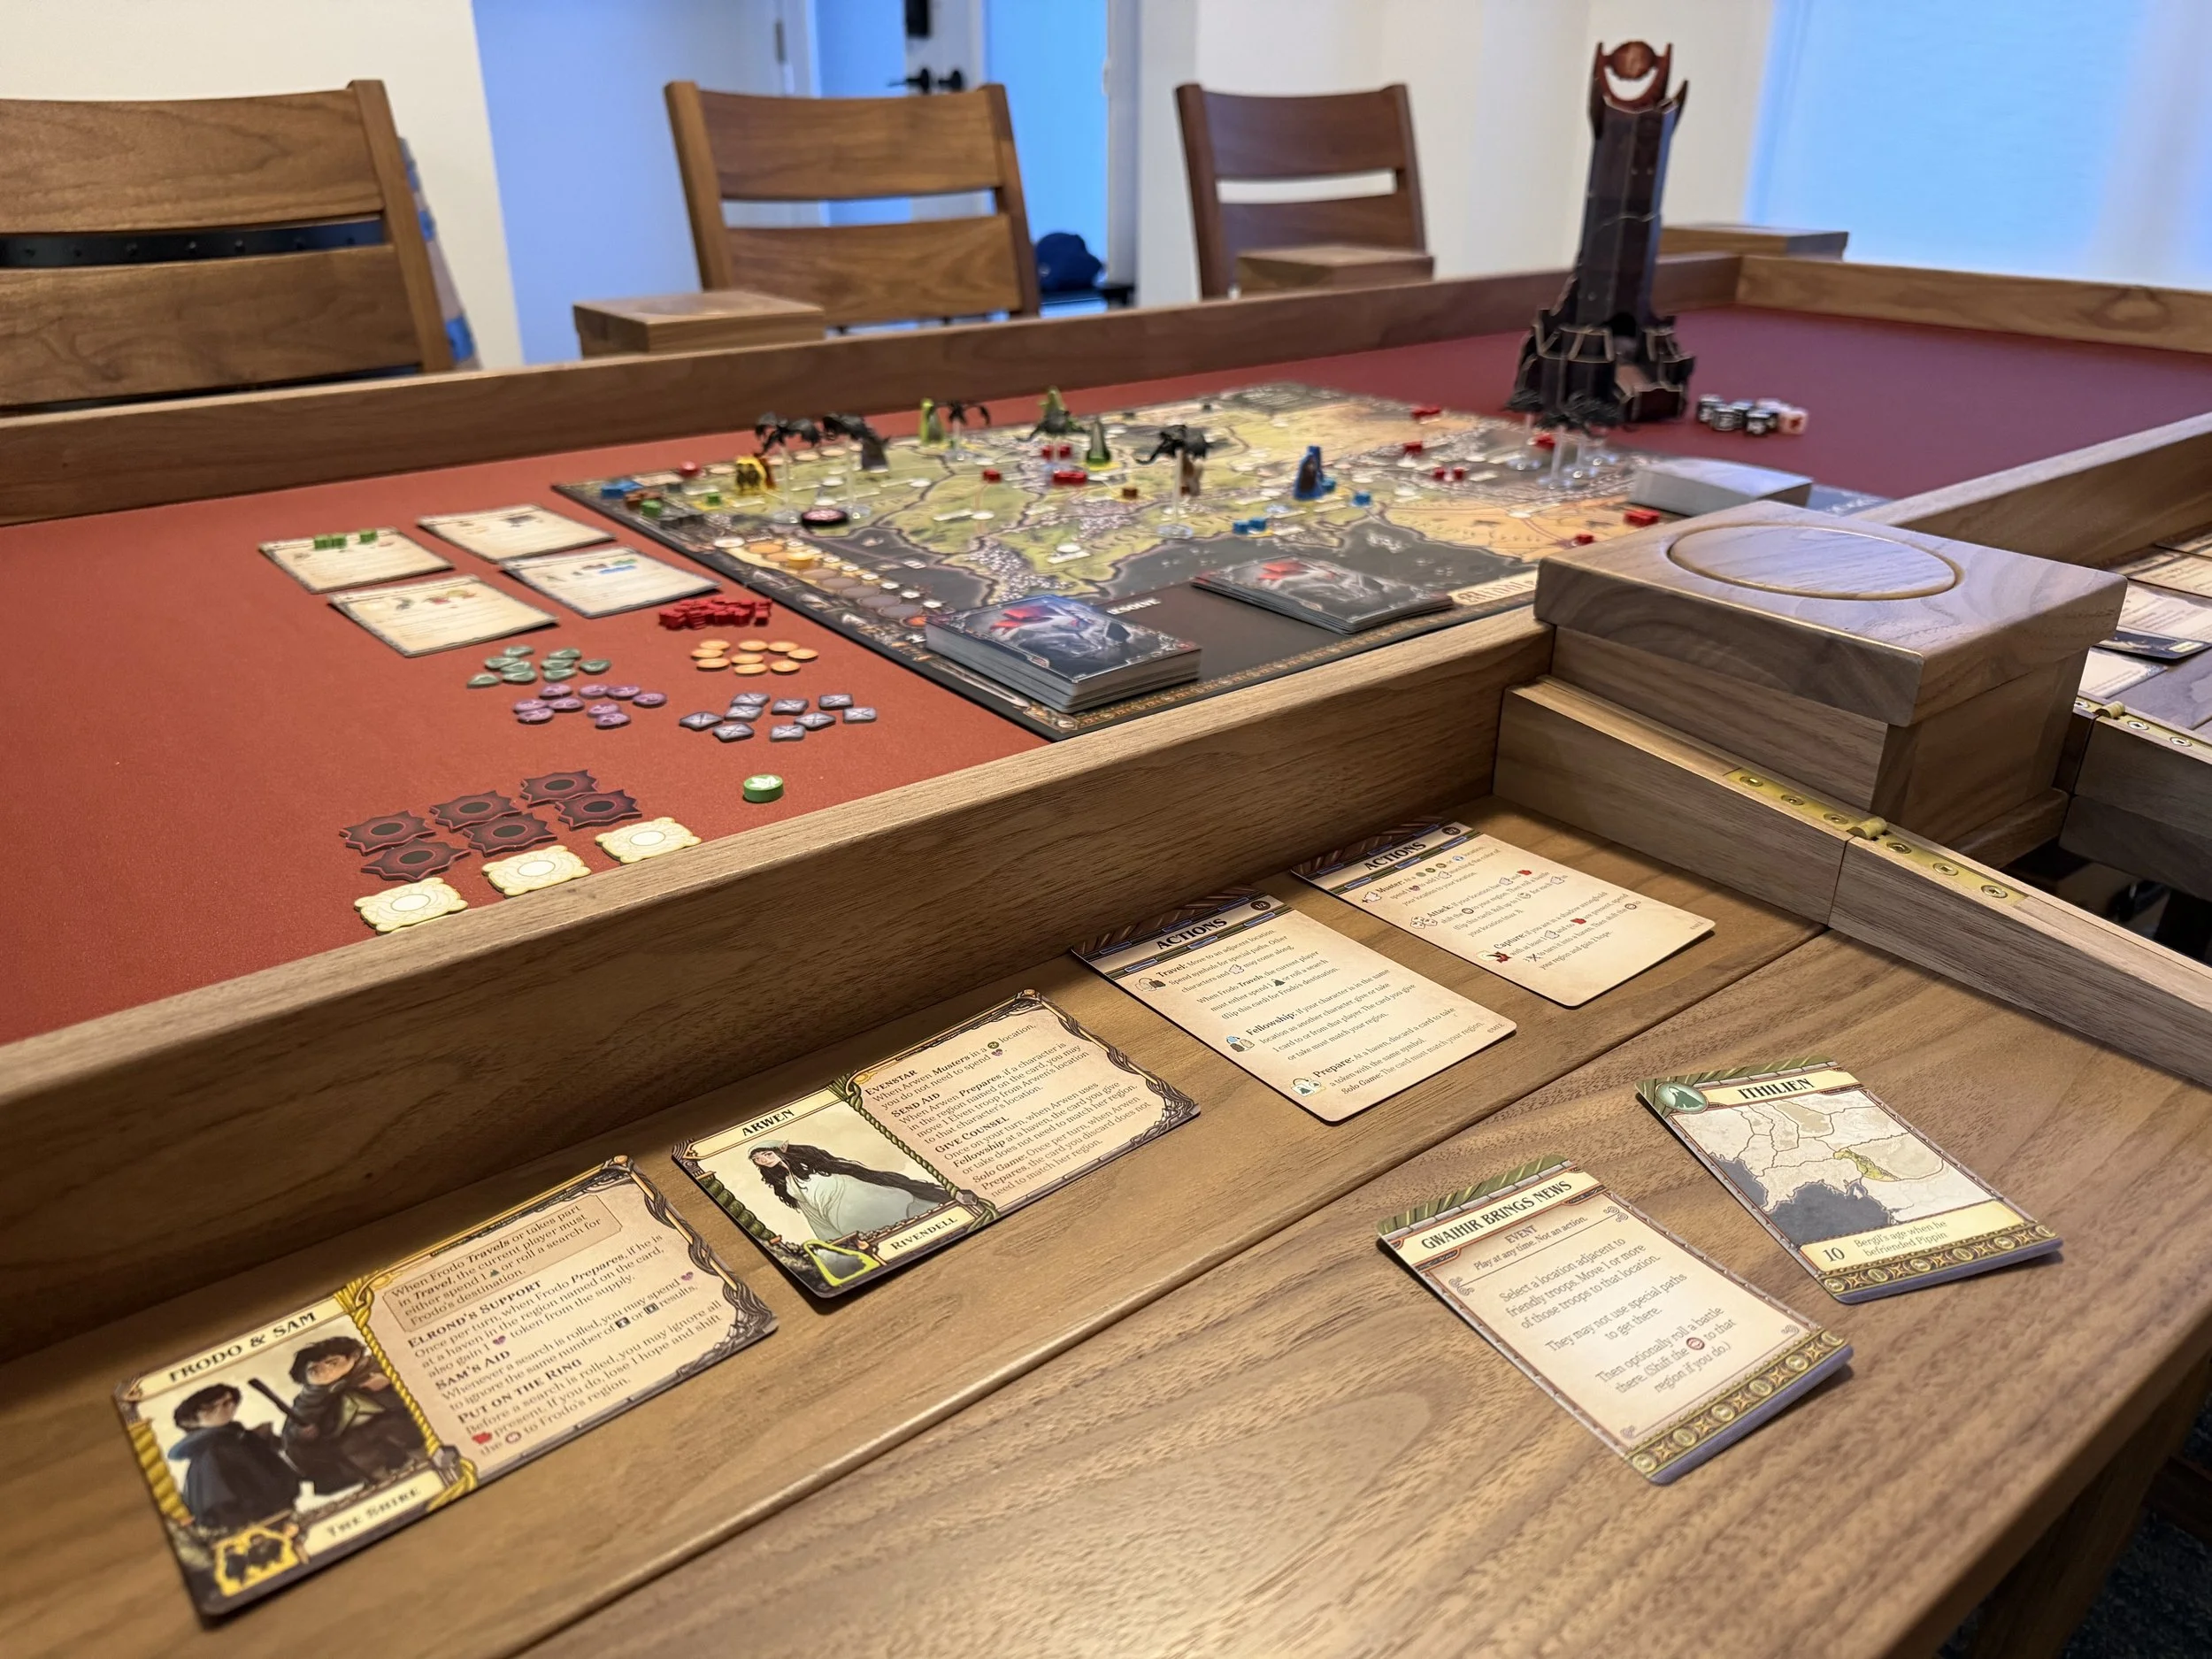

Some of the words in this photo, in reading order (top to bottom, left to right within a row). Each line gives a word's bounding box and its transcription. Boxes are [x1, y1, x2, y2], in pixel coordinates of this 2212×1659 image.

[1156, 918, 1228, 949] ACTIONS
[1302, 1002, 1319, 1012] your
[1317, 988, 1349, 1004] character
[1372, 970, 1391, 979] same
[872, 1087, 903, 1102] When
[902, 1073, 933, 1090] Arwen
[932, 1056, 972, 1076] Musters
[998, 1025, 1037, 1043] location,
[1295, 1048, 1313, 1057] take
[1311, 1040, 1331, 1050] must
[1328, 1029, 1352, 1042] match
[1348, 1023, 1366, 1033] your
[864, 1070, 918, 1095] EVENSTAR
[881, 1098, 902, 1110] you
[900, 1092, 914, 1101] do
[913, 1084, 932, 1094] not
[930, 1072, 955, 1087] need
[964, 1054, 992, 1071] spend
[891, 1102, 921, 1118] SEND
[921, 1093, 941, 1104] AID
[898, 1110, 930, 1124] When
[929, 1095, 961, 1112] Arwen
[958, 1074, 1006, 1097] Prepares,
[1018, 1047, 1058, 1068] character
[917, 1123, 944, 1138] move
[947, 1108, 977, 1122] Elven
[974, 1095, 1002, 1110] troop
[999, 1085, 1024, 1097] from
[1022, 1069, 1056, 1087] Arwen's
[1053, 1051, 1090, 1071] location
[918, 1116, 937, 1125] the
[936, 1102, 968, 1118] region
[966, 1086, 998, 1103] named
[1009, 1073, 1026, 1082] the
[1025, 1062, 1049, 1075] card,
[1046, 1055, 1064, 1066] you
[1063, 1045, 1082, 1056] may
[1738, 1079, 1816, 1099] ITHILIEN
[742, 1109, 795, 1136] ARWEN
[935, 1127, 957, 1139] that
[956, 1103, 1007, 1129] character's
[1003, 1087, 1044, 1105] location.
[935, 1138, 964, 1153] GIVE
[961, 1117, 1010, 1141] COUNSEL
[943, 1147, 972, 1160] Once
[982, 1129, 1005, 1144] your
[1003, 1120, 1029, 1132] turn,
[1025, 1107, 1052, 1121] when
[1050, 1093, 1080, 1110] Arwen
[1078, 1083, 1100, 1094] uses
[953, 1140, 1006, 1168] Fellowship
[1020, 1118, 1054, 1133] haven,
[1050, 1110, 1068, 1119] the
[1066, 1098, 1087, 1111] card
[1086, 1091, 1104, 1103] you
[1102, 1082, 1121, 1094] give
[890, 1217, 958, 1250] RIVENDELL
[1421, 1219, 1485, 1249] GWAIHIR
[1480, 1197, 1536, 1225] BRINGS
[1532, 1180, 1573, 1202] NEWS
[1504, 1225, 1538, 1243] EVENT
[1854, 1233, 1891, 1250] Bergil's
[1889, 1231, 1909, 1240] age
[1907, 1225, 1935, 1235] when
[391, 1279, 429, 1297] When
[429, 1262, 466, 1281] Frodo
[465, 1240, 511, 1263] Travels
[511, 1233, 525, 1242] or
[526, 1218, 557, 1235] takes
[557, 1205, 581, 1222] part
[1473, 1259, 1494, 1271] Play
[1502, 1248, 1518, 1259] any
[1516, 1240, 1538, 1252] time.
[1534, 1233, 1553, 1243] Not
[1561, 1217, 1589, 1232] action.
[1823, 1248, 1846, 1262] 10
[1863, 1238, 1917, 1256] befriended
[1915, 1233, 1949, 1245] Pippin
[1499, 1284, 1533, 1302] Select
[1534, 1263, 1578, 1285] location
[1575, 1243, 1617, 1266] adjacent
[1505, 1294, 1548, 1317] friendly
[1544, 1279, 1581, 1299] troops.
[1575, 1266, 1606, 1282] Move
[1609, 1256, 1622, 1266] or
[1620, 1245, 1647, 1261] more
[1521, 1317, 1535, 1329] of
[1531, 1306, 1562, 1323] those
[1558, 1290, 1593, 1310] troops
[1589, 1285, 1603, 1294] to
[1600, 1274, 1624, 1288] that
[1617, 1256, 1662, 1278] location.
[408, 1311, 479, 1348] ELROND'S
[480, 1281, 541, 1314] SUPPORT
[411, 1302, 456, 1325] Frodo's
[1545, 1335, 1576, 1351] They
[1572, 1324, 1596, 1340] may
[1593, 1315, 1614, 1328] not
[1609, 1306, 1631, 1318] use
[1627, 1286, 1663, 1309] special
[1659, 1273, 1688, 1294] paths
[1604, 1331, 1619, 1340] to
[1617, 1321, 1636, 1336] get
[1632, 1308, 1663, 1325] there.
[169, 1345, 243, 1382] FRODO
[250, 1334, 266, 1348] &
[273, 1312, 317, 1338] SAM
[435, 1364, 482, 1390] SAM'S
[485, 1350, 511, 1368] AID
[1594, 1365, 1627, 1383] Then
[1624, 1338, 1675, 1368] optionally
[1671, 1325, 1691, 1341] roll
[1691, 1308, 1725, 1326] battle
[1615, 1374, 1649, 1394] there.
[1644, 1356, 1675, 1377] (Shift
[1671, 1348, 1691, 1361] the
[1703, 1332, 1717, 1341] to
[1714, 1319, 1738, 1334] that
[1654, 1370, 1688, 1394] region
[1682, 1363, 1697, 1374] if
[1692, 1354, 1715, 1372] you
[1711, 1340, 1732, 1357] do.)
[457, 1405, 488, 1424] PUT
[491, 1393, 513, 1408] ON
[514, 1379, 545, 1395] THE
[545, 1359, 583, 1380] RING
[326, 1517, 362, 1536] THE
[365, 1488, 419, 1518] SHIRE
